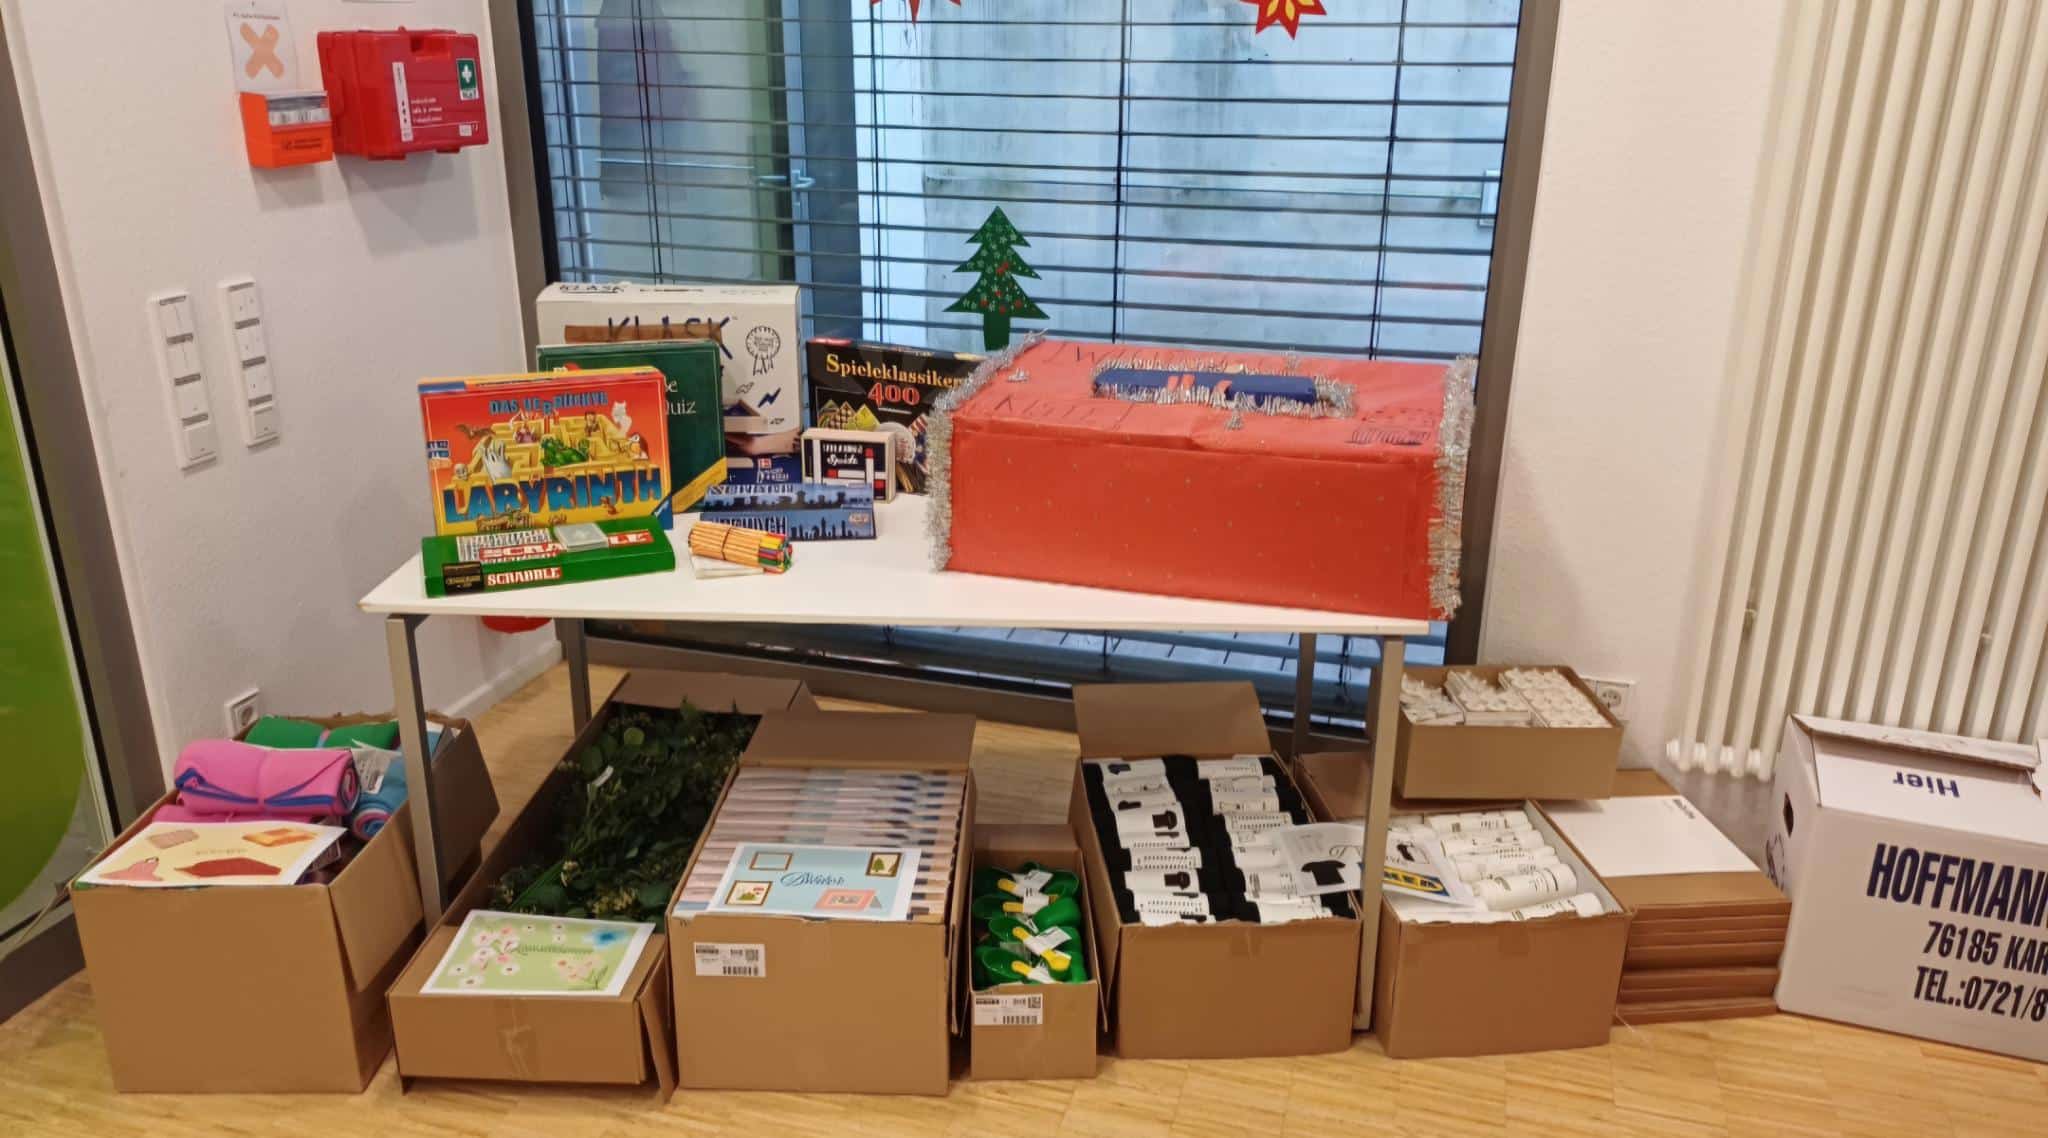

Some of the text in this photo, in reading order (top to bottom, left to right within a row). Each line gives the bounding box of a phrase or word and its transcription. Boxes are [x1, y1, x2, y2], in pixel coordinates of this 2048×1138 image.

[489, 400, 518, 415] DAS
[867, 382, 920, 406] 400
[443, 467, 662, 524] LABYRINTH
[487, 566, 561, 586] SCRABBLE
[1892, 770, 1961, 798] Hier
[1866, 842, 2048, 927] HOFFMAN
[1923, 920, 2003, 967] 76185
